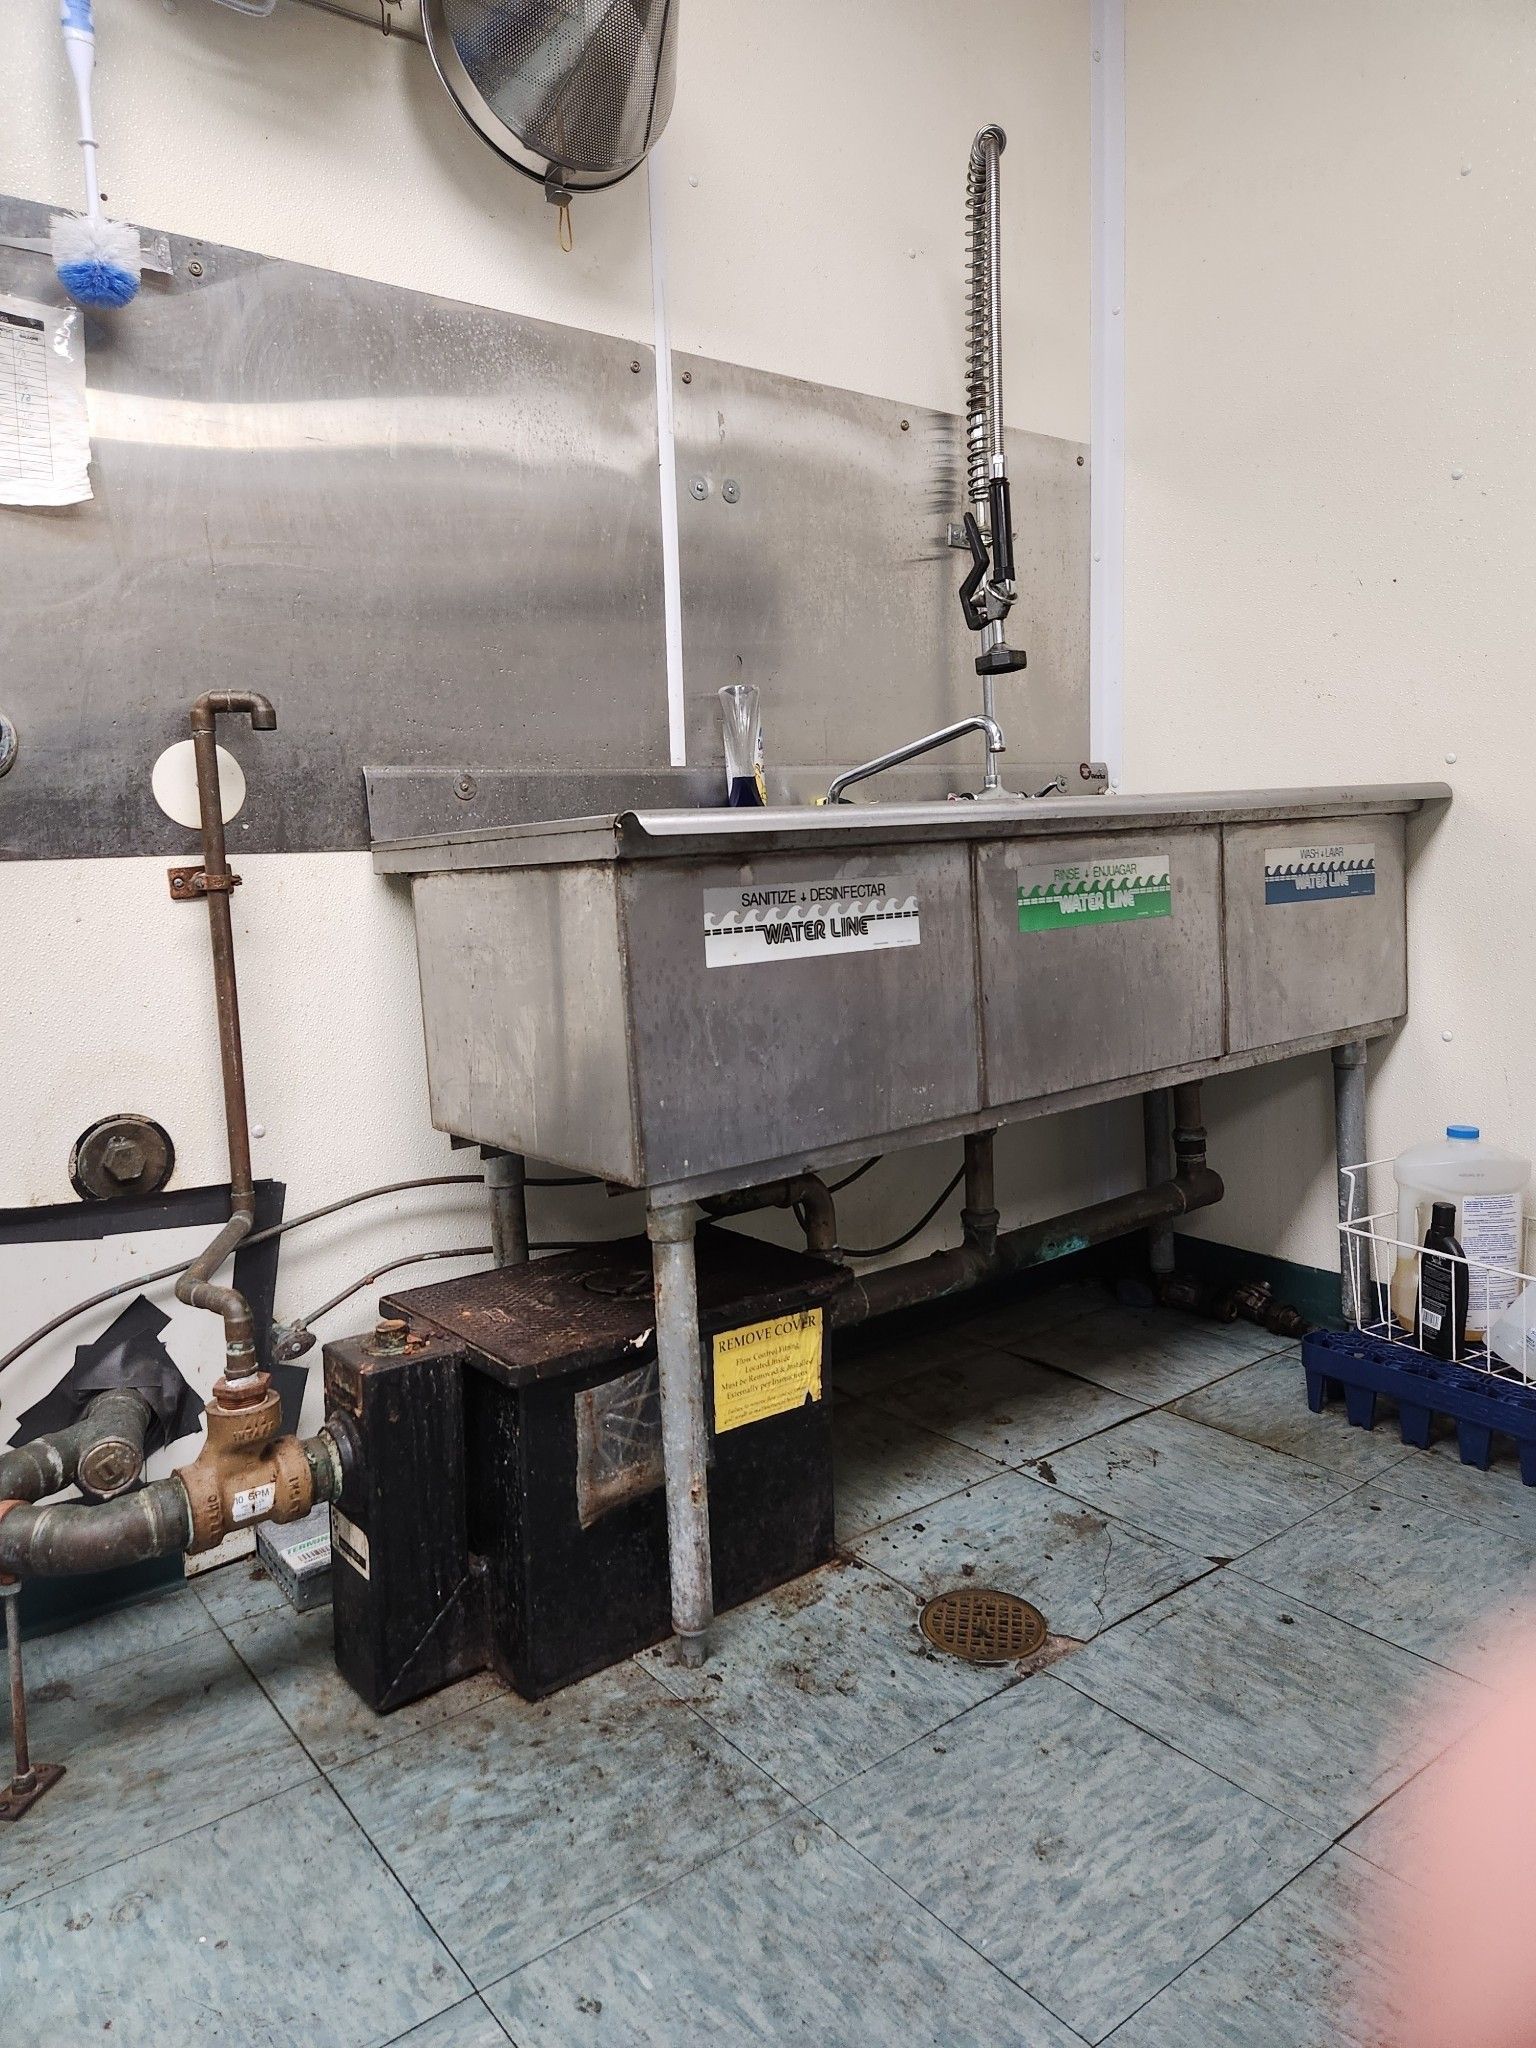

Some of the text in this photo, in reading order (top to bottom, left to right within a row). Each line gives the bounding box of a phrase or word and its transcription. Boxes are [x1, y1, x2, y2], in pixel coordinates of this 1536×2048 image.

[1300, 847, 1344, 859] WASH LAVAR
[1054, 863, 1137, 881] RINSE ENJUAGAR
[1295, 871, 1349, 890] WATER LINE
[741, 883, 886, 907] SANITIZE DESINFECTAR
[1058, 889, 1136, 914] WATER LINE
[761, 914, 869, 945] WATER LINE
[719, 1315, 816, 1353] REMOVE COVER
[248, 1487, 270, 1501] GPM
